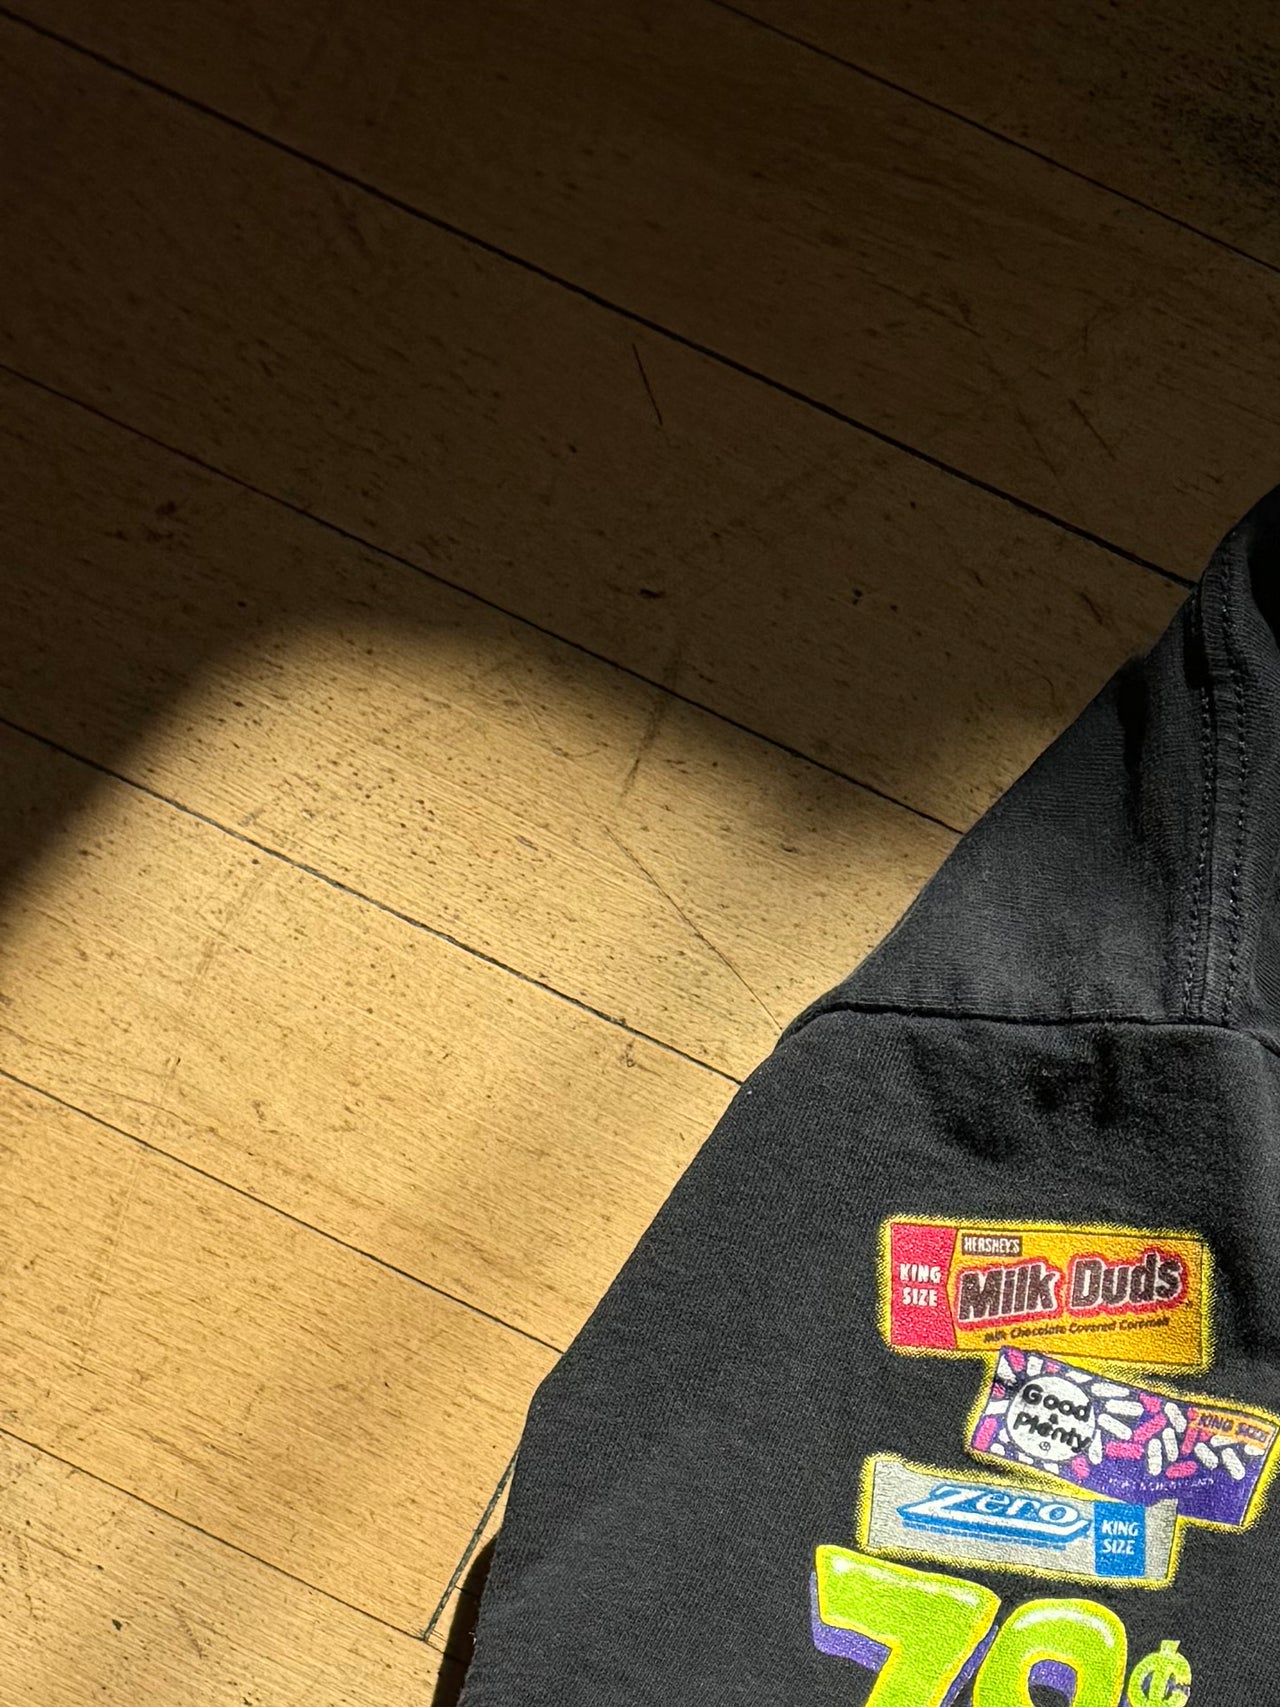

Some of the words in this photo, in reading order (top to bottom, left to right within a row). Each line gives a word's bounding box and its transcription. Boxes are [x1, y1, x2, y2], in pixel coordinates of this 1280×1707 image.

[900, 1263, 941, 1285] KING
[903, 1287, 937, 1307] SIZE
[958, 1262, 1059, 1322] Milk
[1069, 1250, 1183, 1311] Duds
[1022, 1384, 1092, 1423] Good
[903, 1484, 1089, 1536] Zero
[1102, 1519, 1139, 1538] KING
[1102, 1539, 1136, 1556] SIZE
